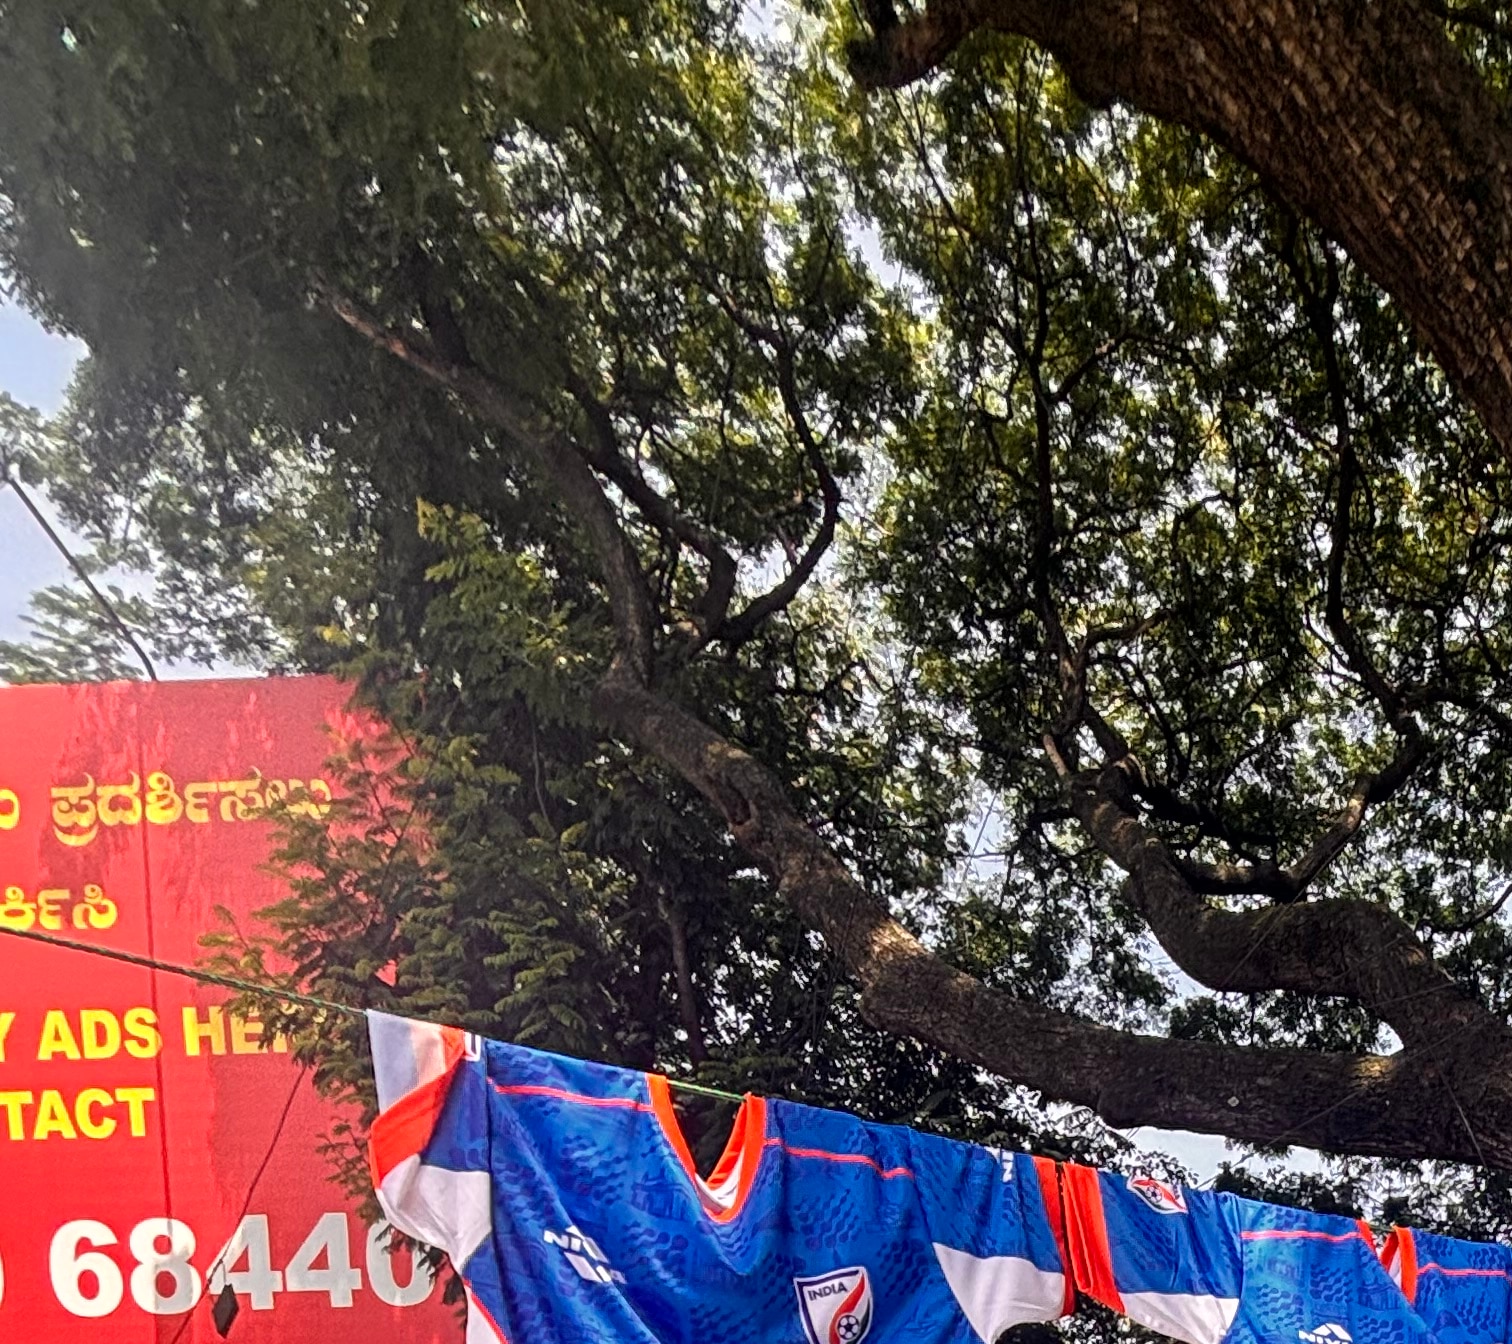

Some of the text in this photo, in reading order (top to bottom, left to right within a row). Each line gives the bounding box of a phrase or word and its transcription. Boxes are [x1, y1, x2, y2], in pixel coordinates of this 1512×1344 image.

[37, 1006, 160, 1061] ADS
[0, 1088, 155, 1140] TACT
[49, 1211, 436, 1318] 68440
[807, 1281, 848, 1301] INDIA
